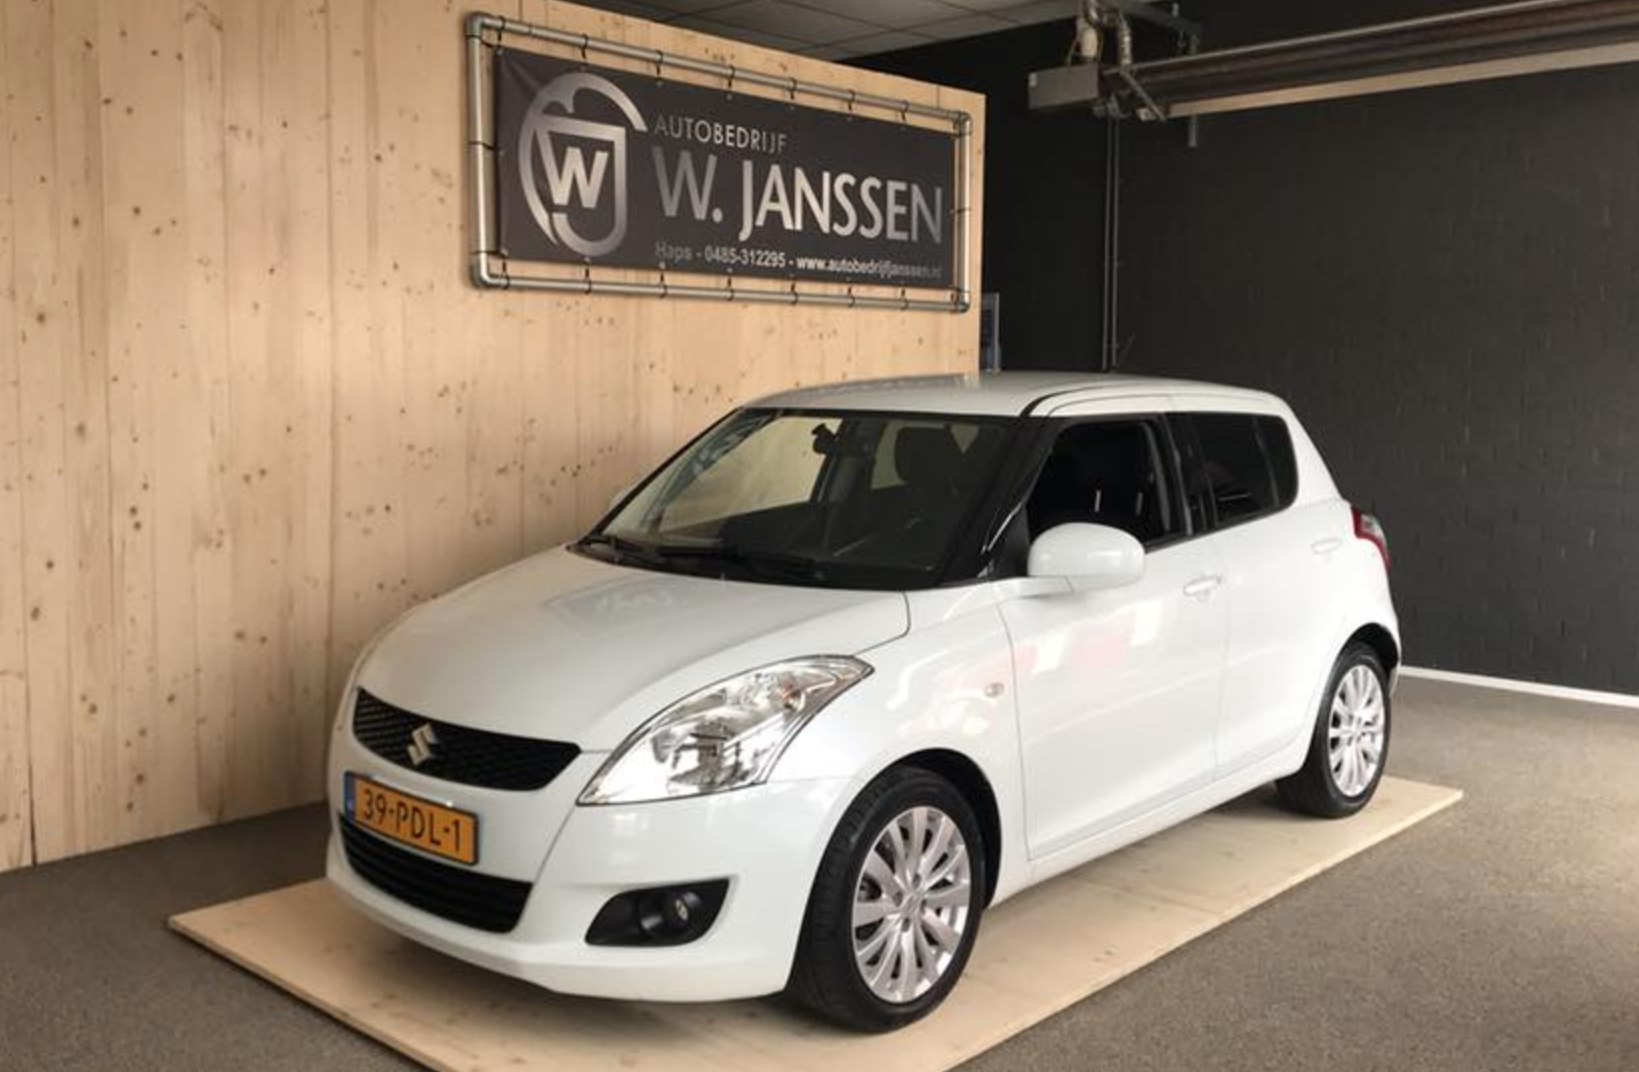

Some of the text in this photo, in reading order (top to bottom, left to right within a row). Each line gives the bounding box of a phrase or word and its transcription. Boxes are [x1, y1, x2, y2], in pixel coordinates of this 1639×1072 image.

[654, 114, 787, 154] AUTOBEDRIJF
[652, 146, 943, 244] W. JANSSEN
[655, 241, 693, 262] Haps
[704, 245, 786, 267] 0485-312295
[364, 788, 461, 853] 39-PDL-1
